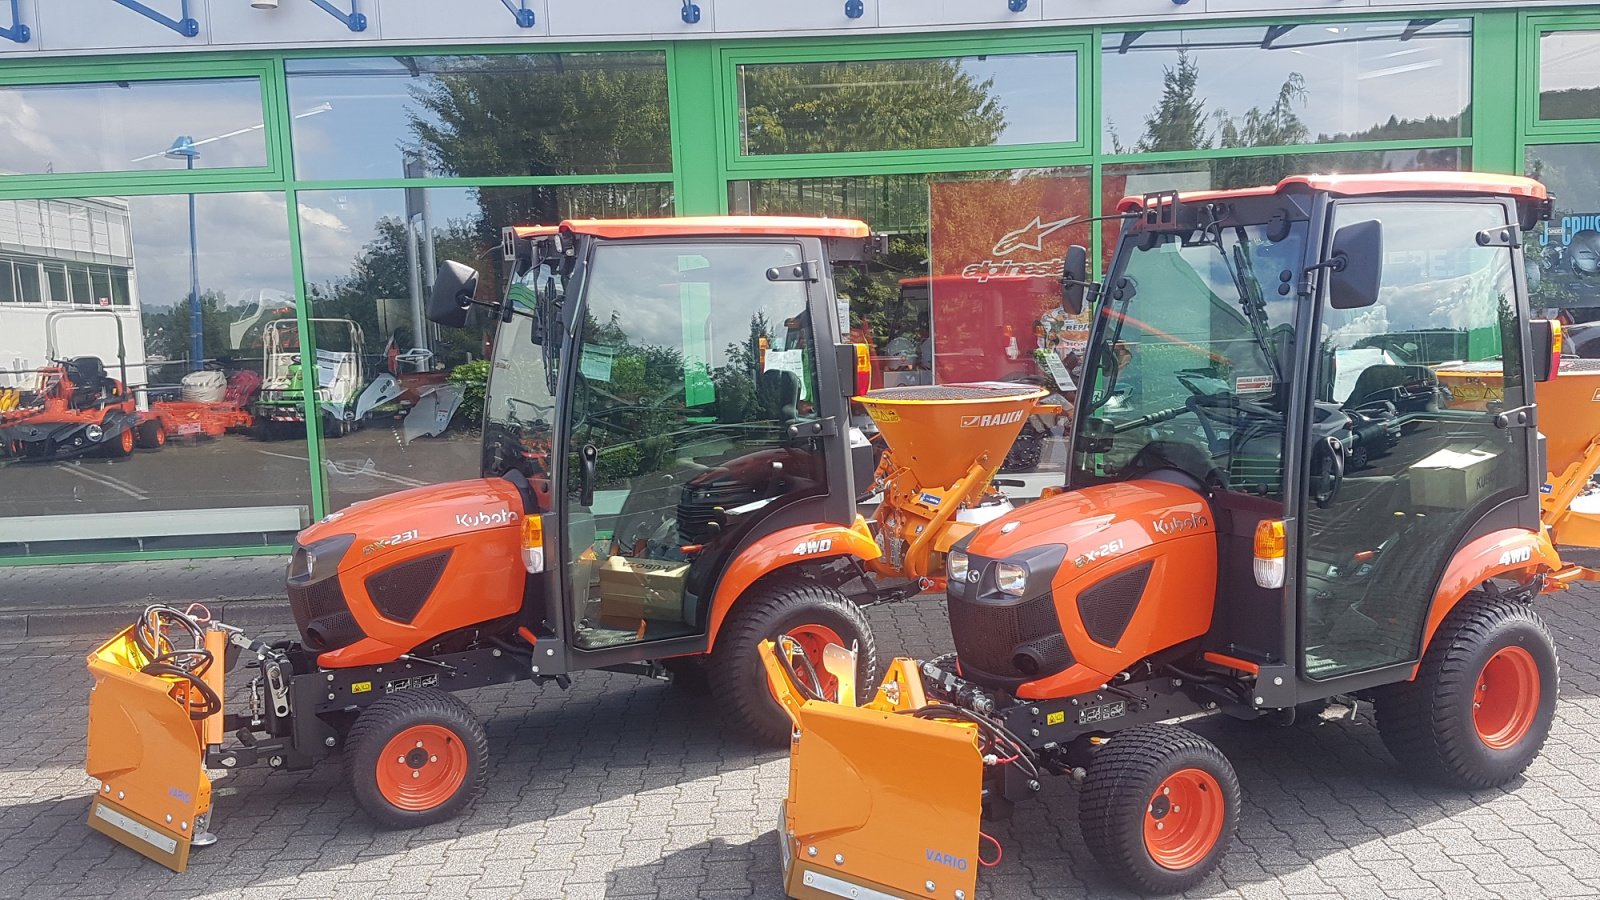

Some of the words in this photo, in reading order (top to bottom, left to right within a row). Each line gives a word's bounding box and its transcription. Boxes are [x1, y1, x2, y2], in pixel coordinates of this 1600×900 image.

[980, 409, 1024, 427] RAUCH
[455, 508, 519, 527] Kubota
[1152, 512, 1209, 535] Kubota
[792, 538, 832, 555] 4WD
[1498, 546, 1531, 566] 4WD
[925, 848, 968, 871] VARIO
